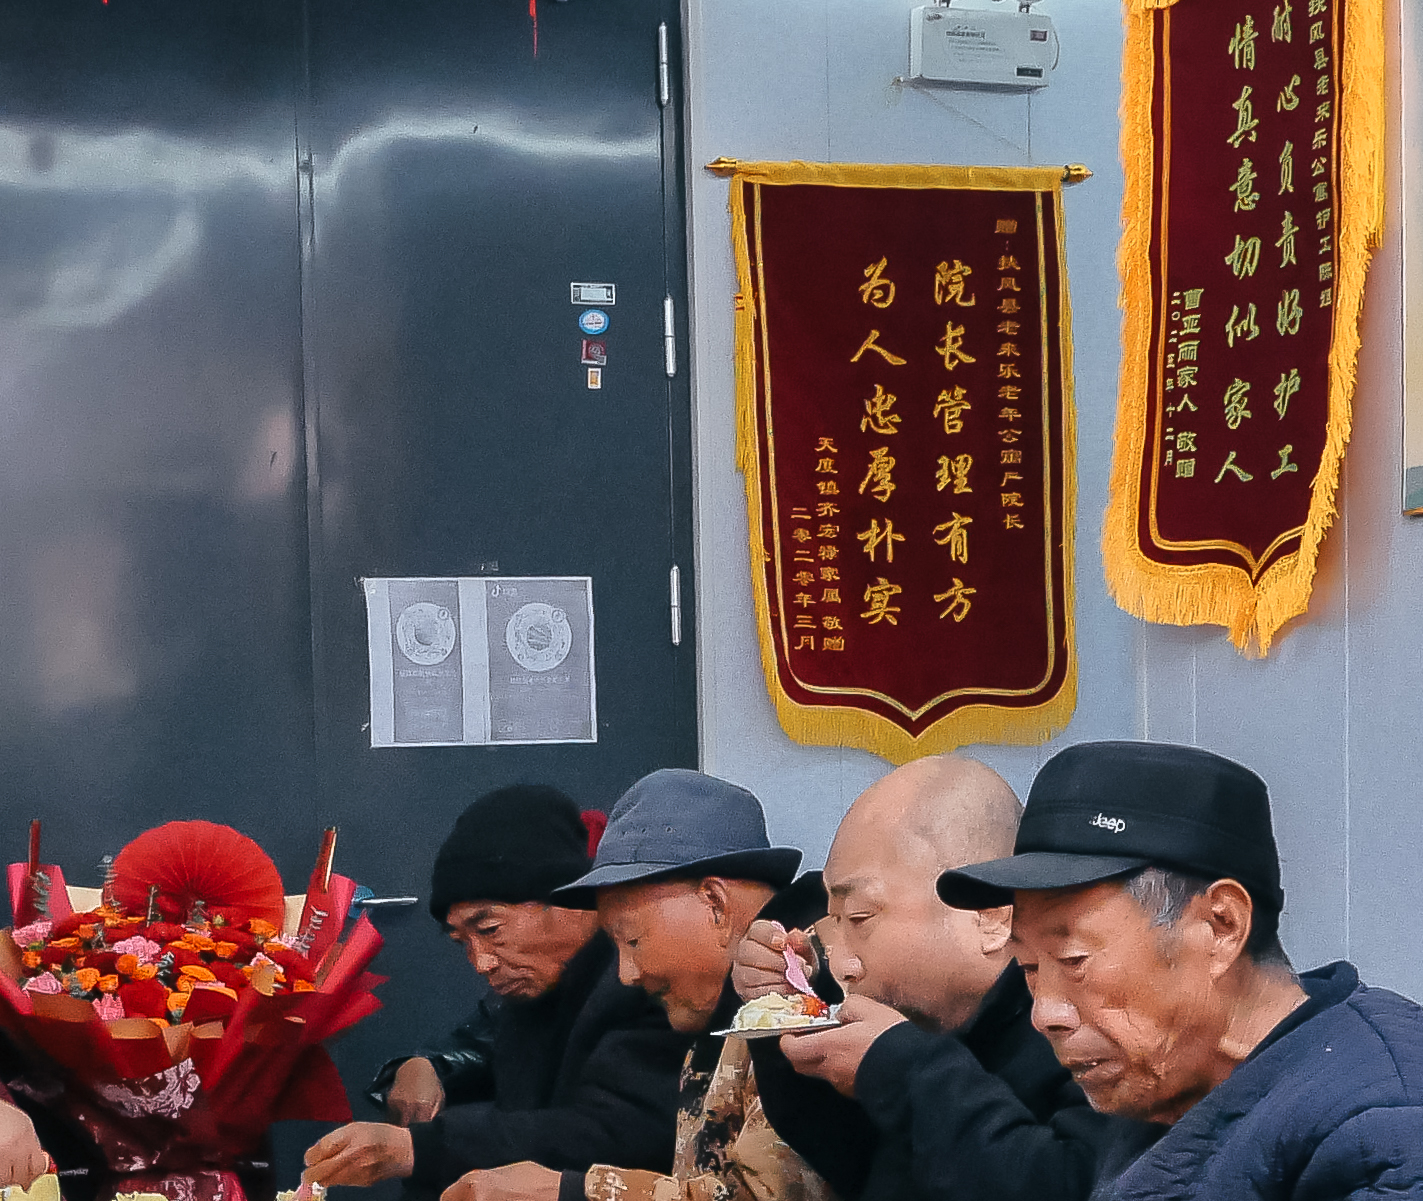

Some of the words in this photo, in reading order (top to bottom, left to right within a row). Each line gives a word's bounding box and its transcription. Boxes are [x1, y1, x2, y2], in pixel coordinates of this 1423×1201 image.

[1213, 14, 1261, 485] 情真意切似家人
[850, 255, 908, 628] 为人忠厚朴实
[932, 259, 978, 625] 院长管理有方
[1089, 812, 1126, 834] Jeep
